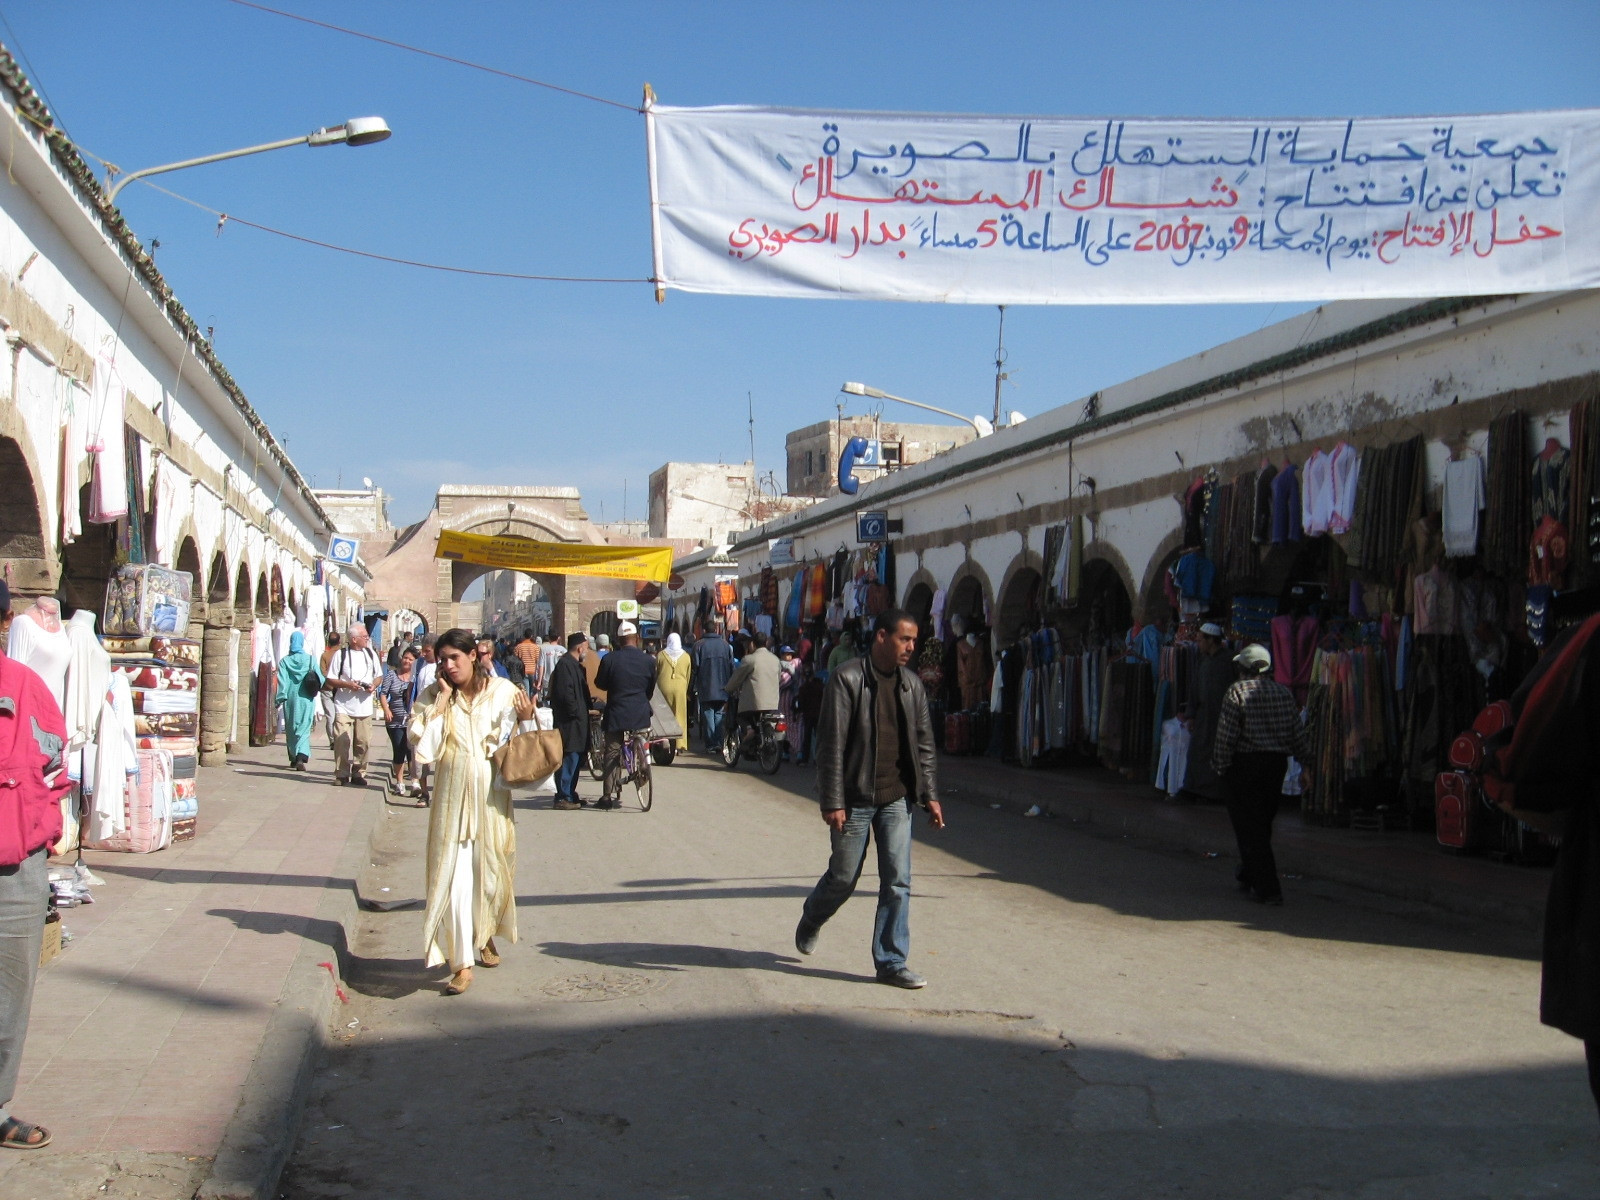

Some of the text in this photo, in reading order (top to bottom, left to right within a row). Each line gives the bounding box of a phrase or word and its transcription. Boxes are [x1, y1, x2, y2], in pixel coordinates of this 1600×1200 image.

[822, 118, 1559, 180] جمعية حماية المستهلك بالصويرة
[1424, 184, 1468, 213] عن
[1475, 163, 1568, 210] تعلن
[727, 210, 839, 263] الصويري
[839, 207, 907, 260] بدار
[976, 219, 998, 249] 5
[1001, 211, 1091, 253] الساعة
[1084, 216, 1132, 267] على
[1133, 218, 1205, 252] 2007
[1233, 215, 1249, 252] 9
[1249, 212, 1334, 256] الجمعة
[1324, 234, 1372, 272] يوم
[1472, 207, 1563, 258] حفل
